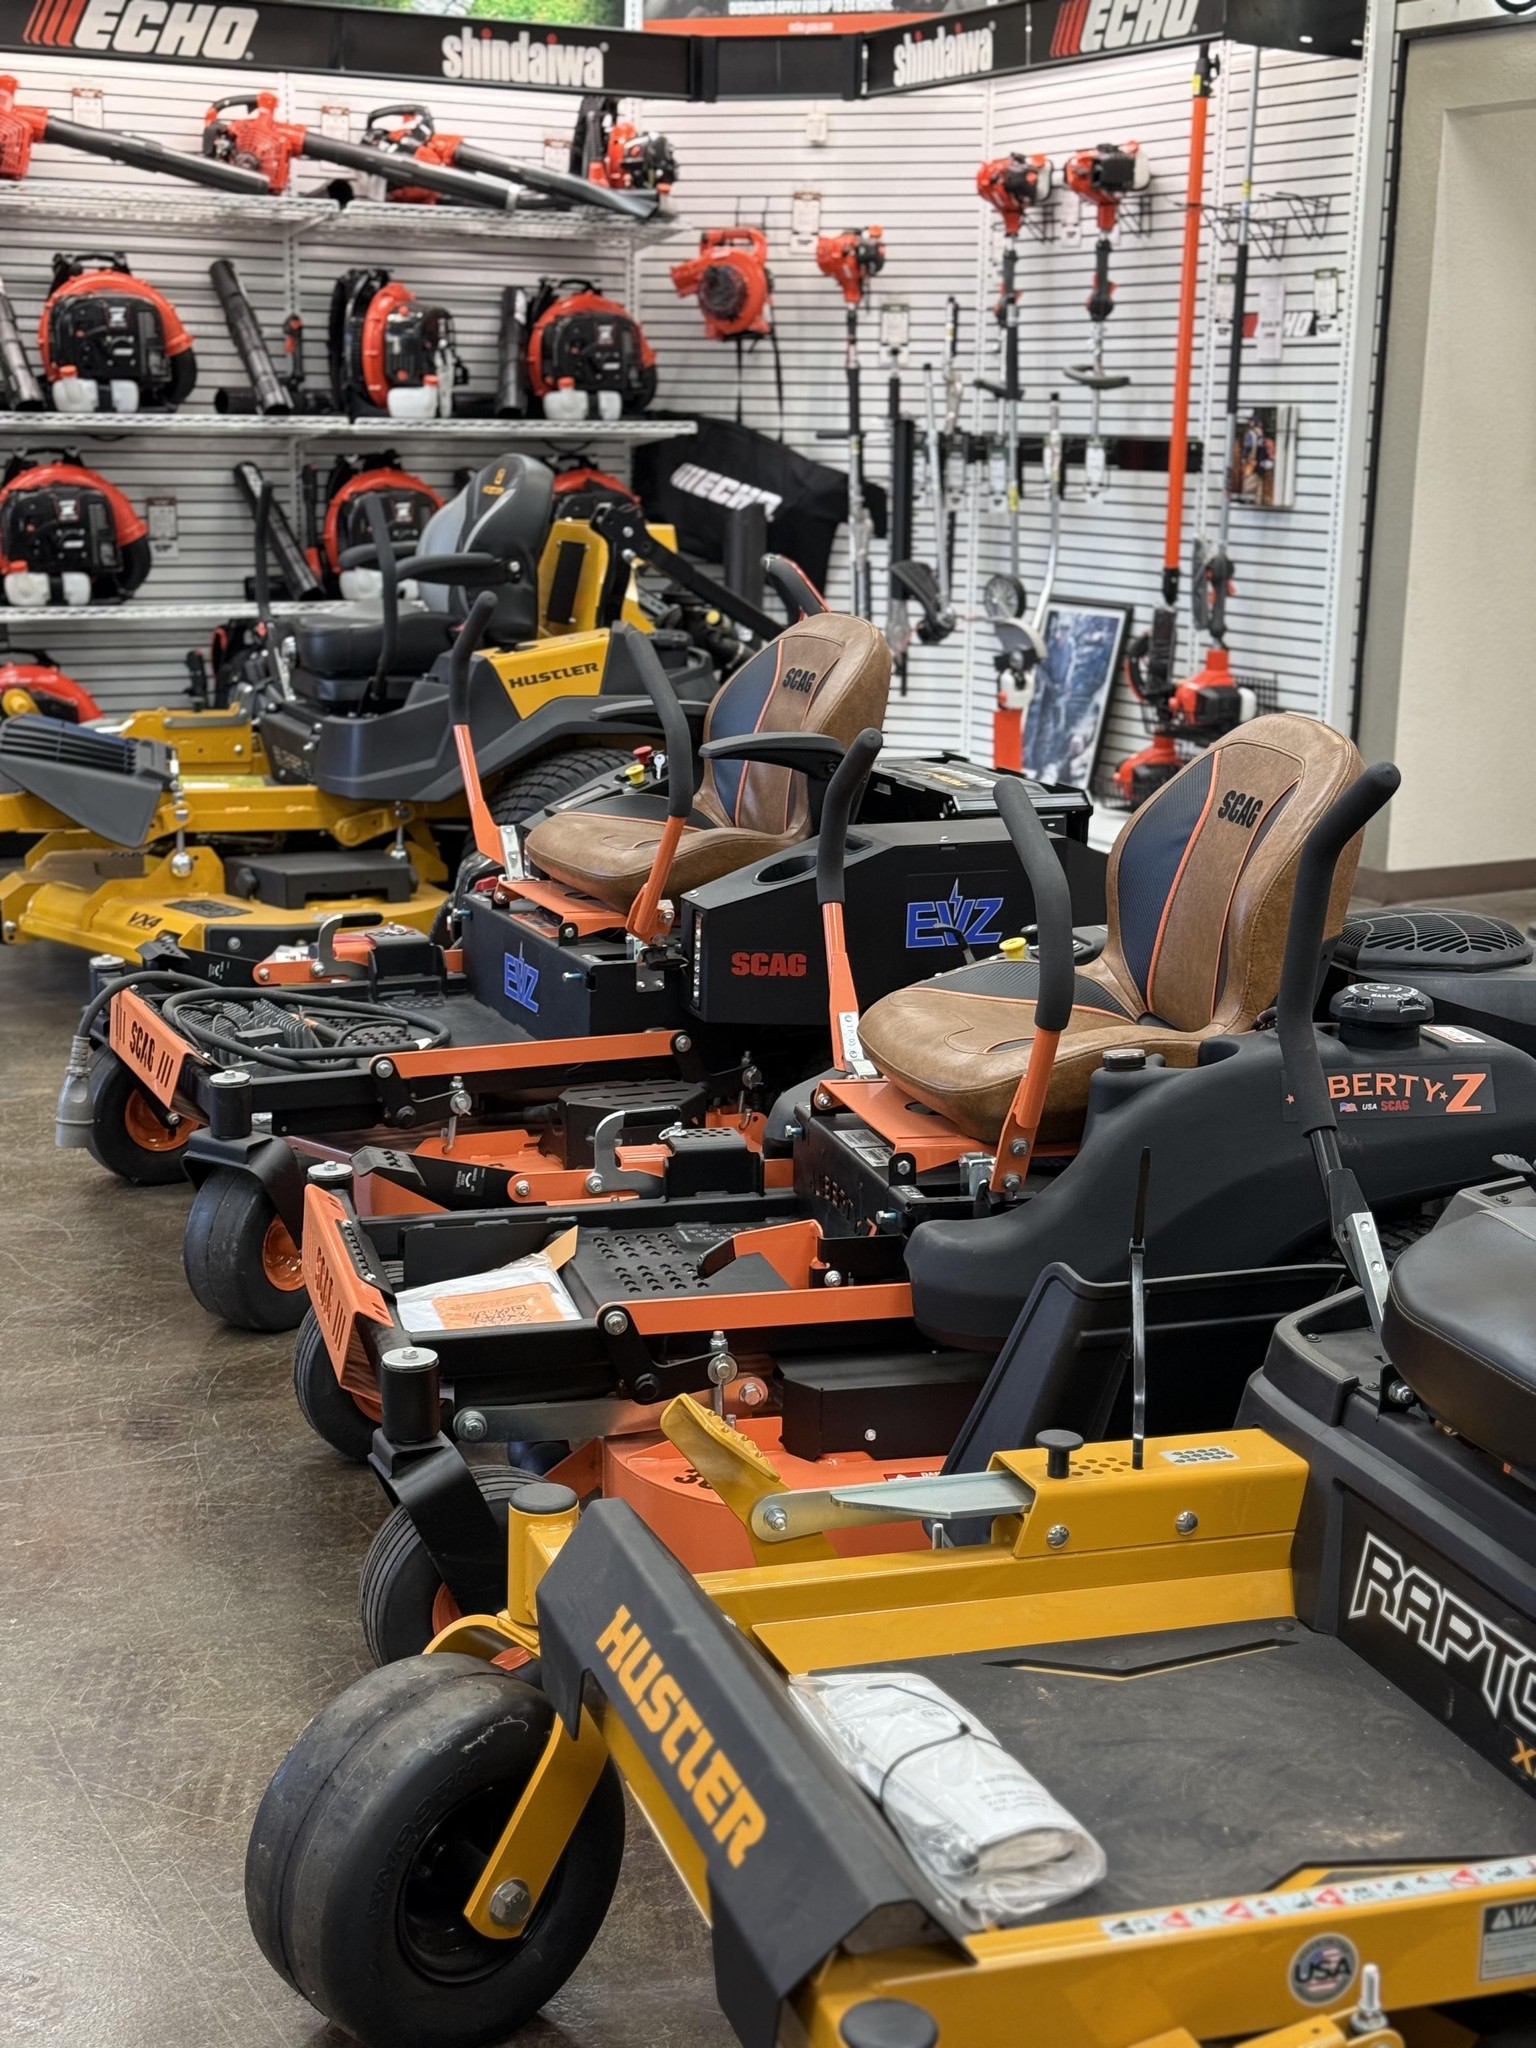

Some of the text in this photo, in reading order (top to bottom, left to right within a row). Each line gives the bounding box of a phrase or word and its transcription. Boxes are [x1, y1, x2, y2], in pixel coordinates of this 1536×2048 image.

[74, 0, 259, 60] ECHO
[442, 26, 604, 88] shindaiwa
[894, 22, 993, 87] shindaiwa
[508, 662, 600, 689] HUSTLER
[781, 667, 816, 694] SCAG
[1217, 790, 1264, 829] SCAG
[127, 911, 163, 930] VX4
[731, 952, 807, 978] SCAG
[129, 1020, 156, 1073] SCAG
[1327, 1072, 1487, 1112] BERTY Z
[1362, 1100, 1409, 1111] USA SCAG
[595, 1604, 767, 1868] HUSTLER
[1294, 1956, 1352, 1984] USA
